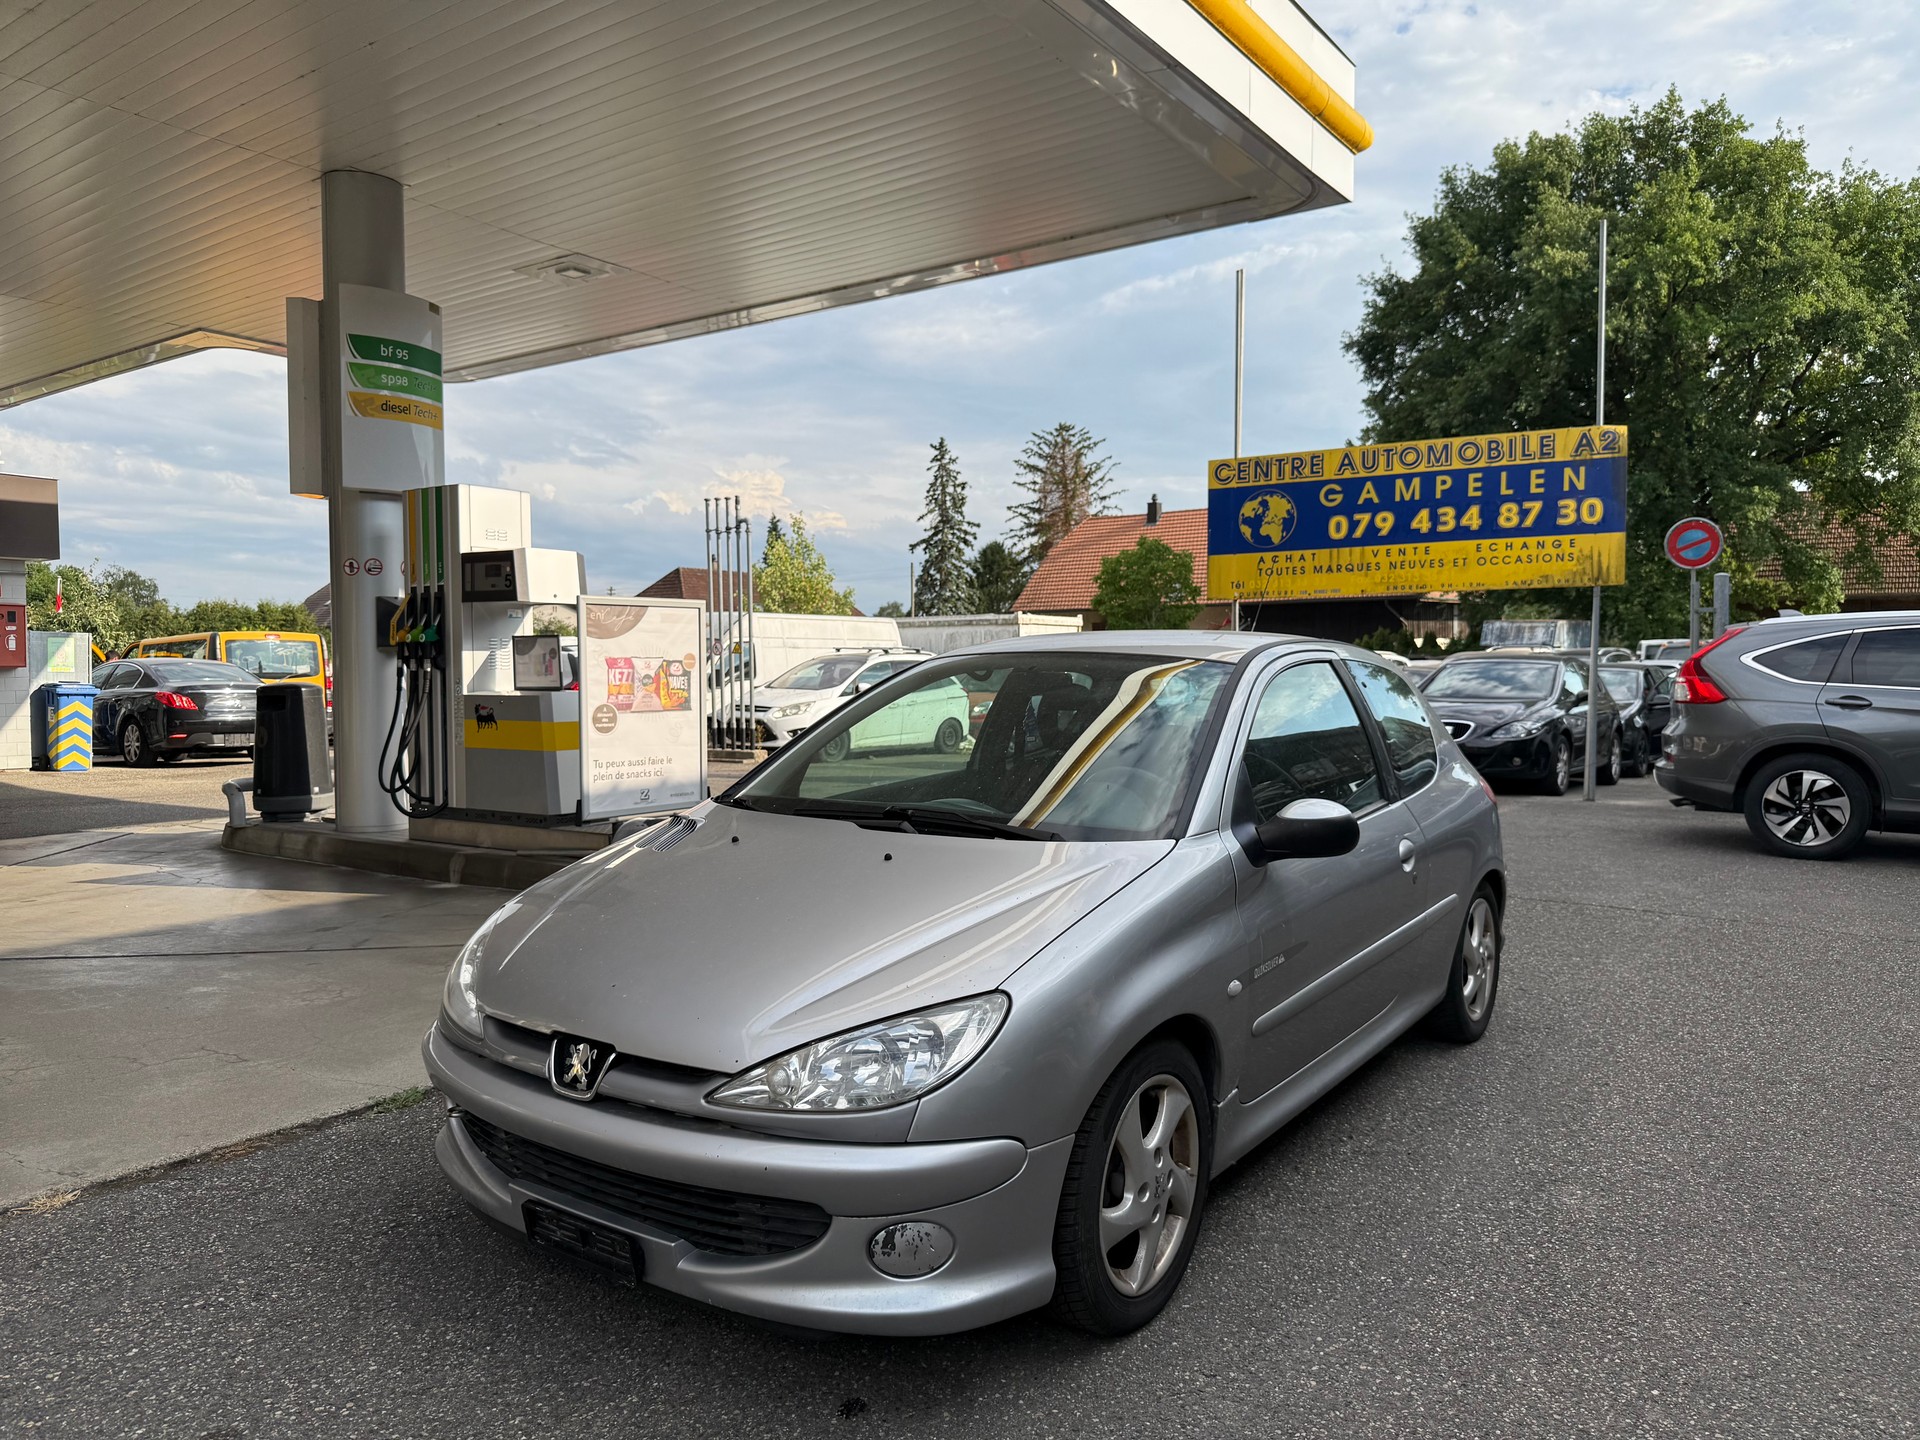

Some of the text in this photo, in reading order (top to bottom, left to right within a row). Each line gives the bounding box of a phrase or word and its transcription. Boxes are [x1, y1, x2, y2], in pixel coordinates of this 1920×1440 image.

[381, 344, 409, 360] bf 95
[381, 373, 409, 387] sp98
[380, 400, 439, 421] diesel Tech+
[1213, 429, 1620, 485] CENTRE AUTOMOBILE A2
[1319, 466, 1586, 507] GAMPELEN
[1327, 497, 1604, 540] 079 434 87 30
[1258, 538, 1576, 565] ACHAT VENTE ECHANGE
[1258, 552, 1576, 577] TOUTES MARQUES NEUVES ET OCCASIONS
[504, 574, 512, 589] 5
[593, 755, 673, 770] Tu peux aussi faire le
[593, 772, 613, 783] plein
[615, 771, 624, 780] de
[626, 769, 652, 779] snacks
